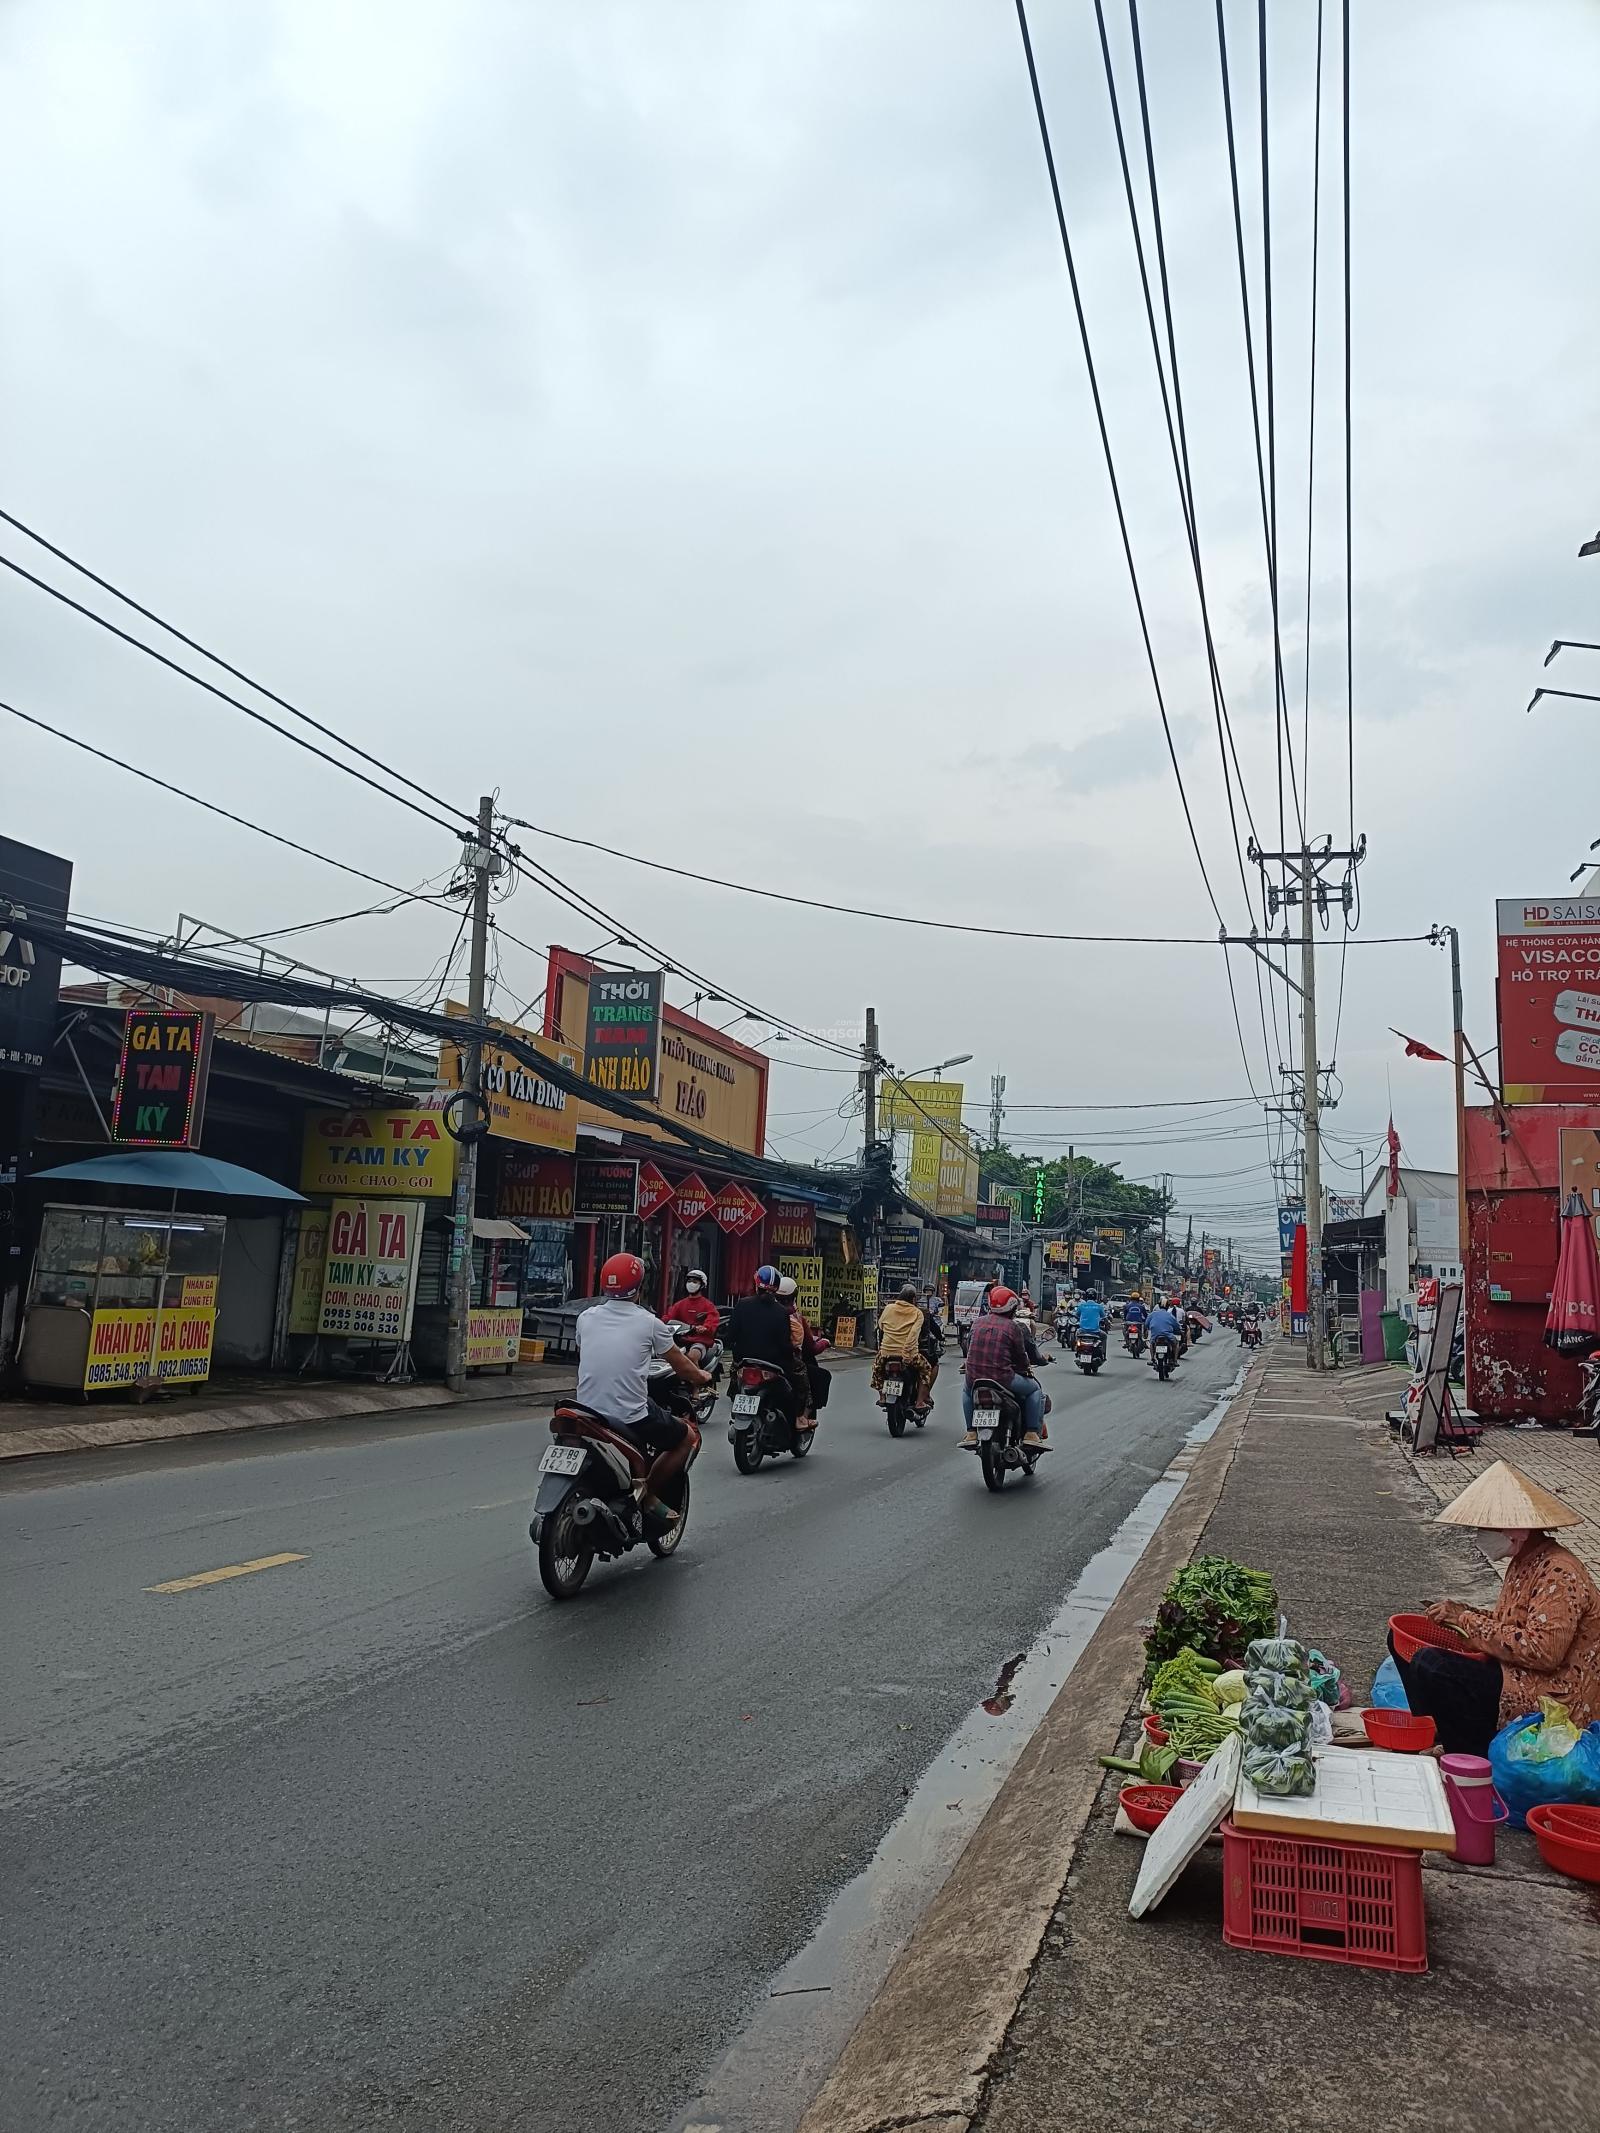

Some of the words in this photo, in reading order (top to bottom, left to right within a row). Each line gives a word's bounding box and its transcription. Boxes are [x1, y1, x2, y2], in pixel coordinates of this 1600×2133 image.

[1523, 906, 1550, 921] HD
[1511, 968, 1533, 982] HỖ
[1538, 969, 1571, 983] TRỢ
[600, 979, 650, 1000] THỜI
[593, 1005, 653, 1022] TRANG
[132, 1021, 162, 1052] GÀ
[166, 1026, 192, 1052] TA
[594, 1027, 648, 1044] NAM
[588, 1056, 619, 1091] ANH
[686, 1048, 717, 1077] TRANG
[715, 1064, 736, 1085] NAM
[136, 1064, 181, 1092] TAM
[386, 1118, 442, 1140] TA
[328, 1146, 386, 1166] TAM
[912, 1158, 938, 1177] QUAY
[939, 1166, 965, 1191] QUAY
[1034, 1172, 1045, 1223] HASAKI
[676, 1200, 707, 1217] 150K
[717, 1206, 746, 1223] 100K
[777, 1205, 809, 1218] SHOP
[988, 1207, 1010, 1222] QUAY
[331, 1202, 369, 1257] GÀ
[378, 1212, 406, 1260] TA
[770, 1224, 791, 1244] ANH
[327, 1261, 355, 1285] TAM
[801, 1258, 821, 1281] YÊN
[864, 1281, 877, 1294] YÊN
[800, 1296, 819, 1308] KEO
[323, 1308, 352, 1319] 0985
[354, 1310, 375, 1321] 548
[378, 1312, 400, 1323] 330
[160, 1314, 177, 1352] GÀ
[180, 1314, 211, 1351] CÚNG
[322, 1319, 350, 1331] 0932
[353, 1321, 374, 1332] 006
[377, 1323, 399, 1335] 536
[88, 1361, 151, 1384] 0985.548.330
